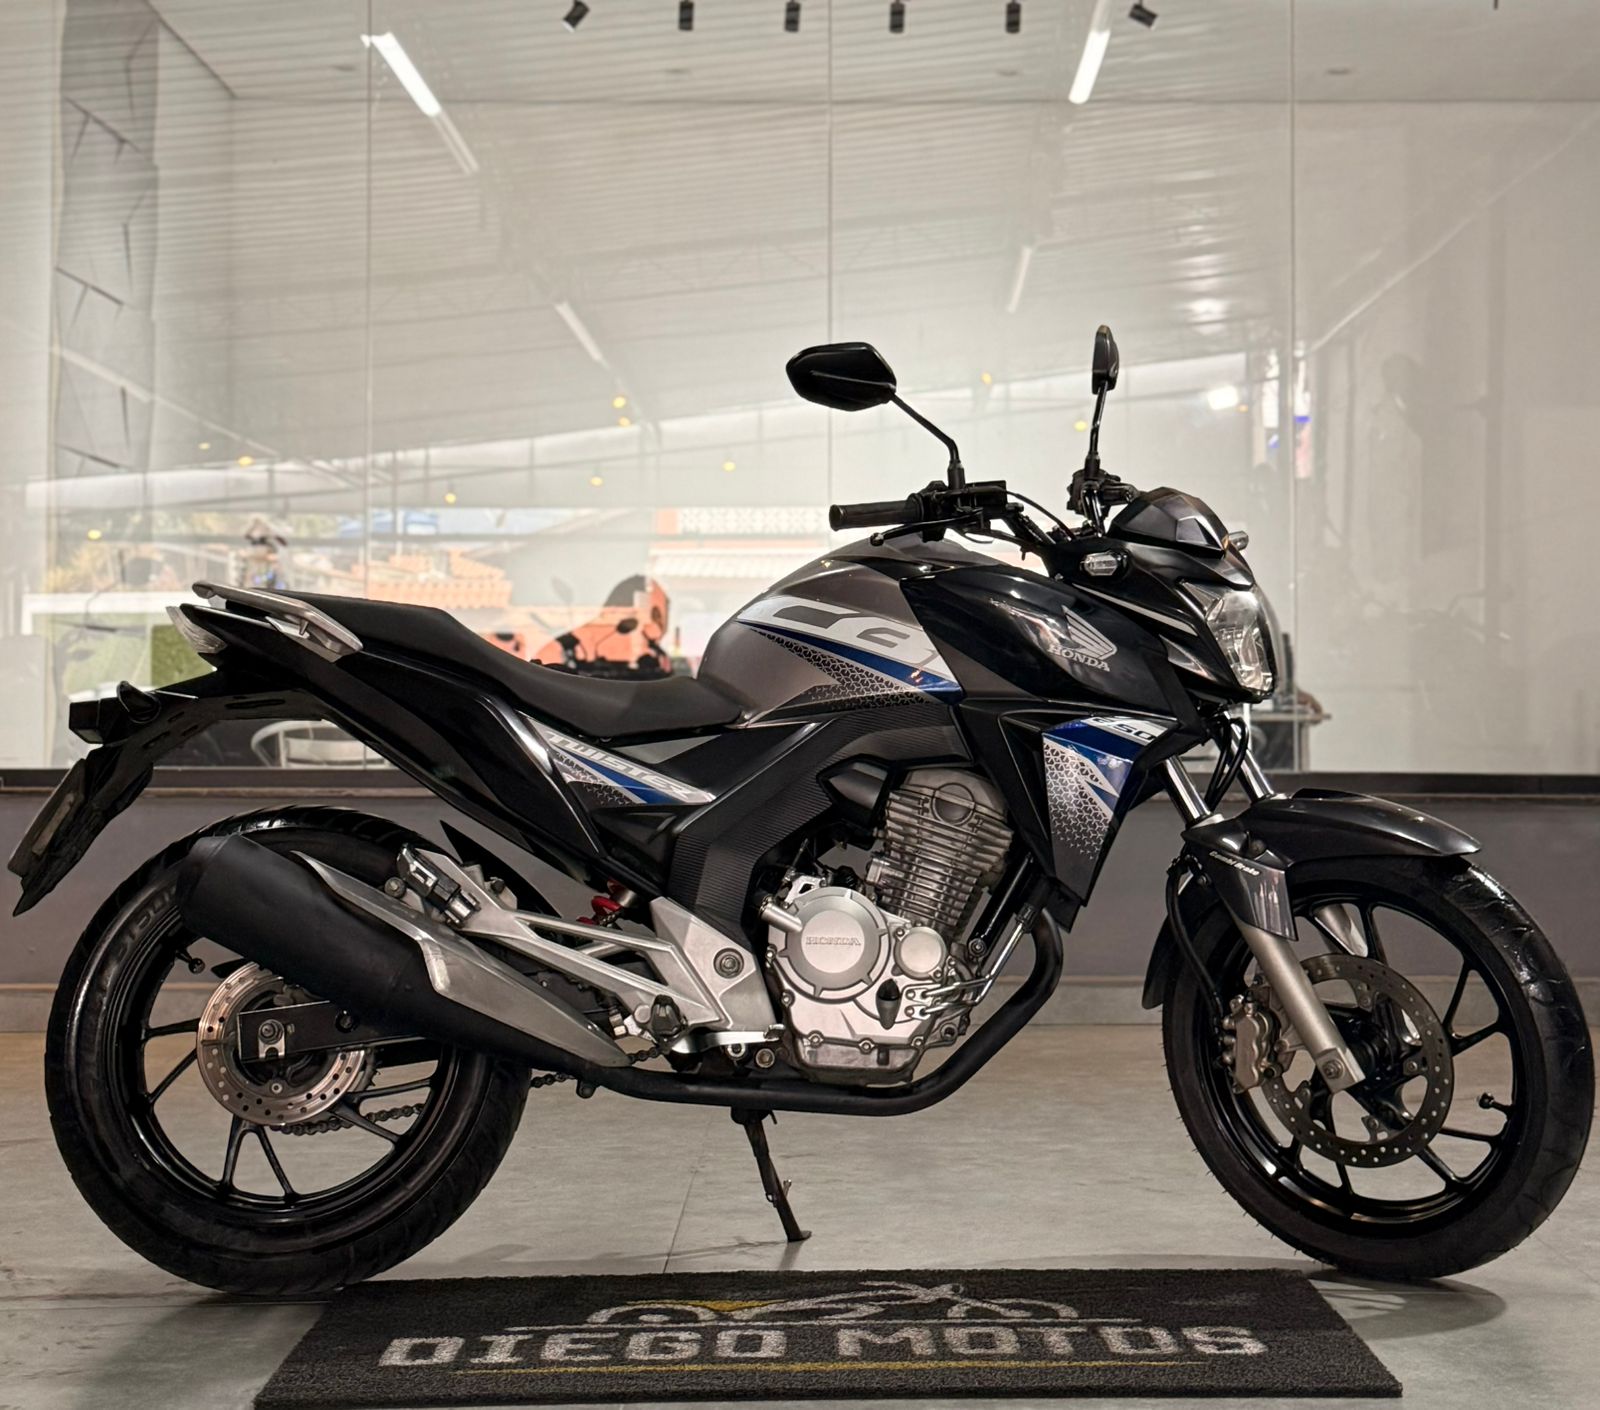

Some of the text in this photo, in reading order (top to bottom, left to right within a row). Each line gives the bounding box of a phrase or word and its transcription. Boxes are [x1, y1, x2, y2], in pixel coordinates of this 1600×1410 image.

[1049, 644, 1111, 672] HONDA
[549, 732, 690, 798] TWISTER
[805, 936, 861, 946] HONDA
[378, 1325, 1268, 1367] DIEGO MOTOS
